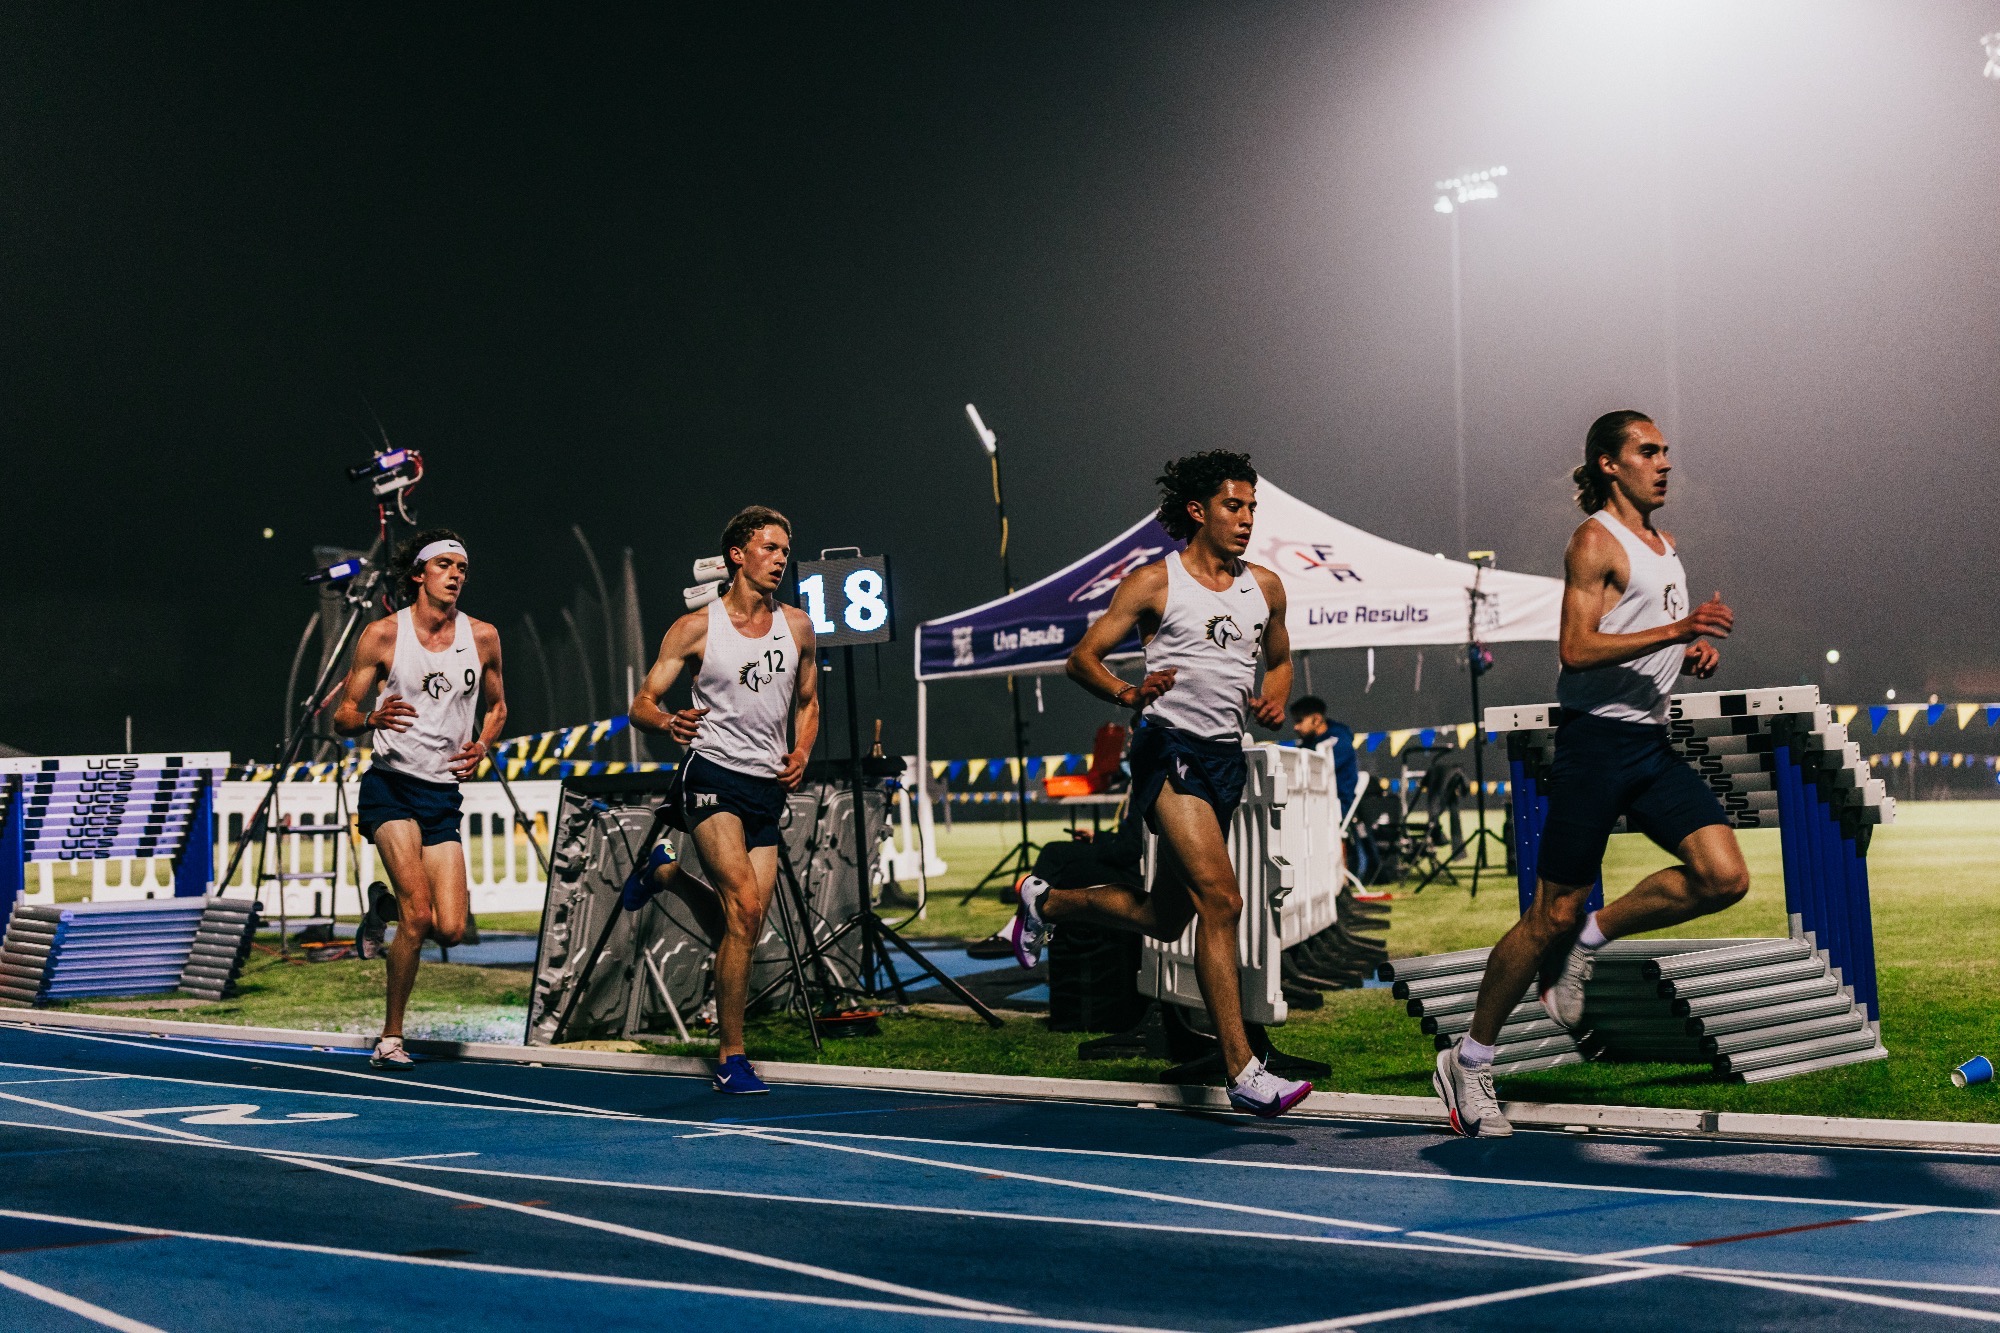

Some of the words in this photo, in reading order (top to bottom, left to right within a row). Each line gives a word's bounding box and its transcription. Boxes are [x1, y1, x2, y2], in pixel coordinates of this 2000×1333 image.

[799, 569, 888, 634] 18
[1308, 607, 1348, 625] Live
[1355, 605, 1429, 623] Results
[993, 631, 1018, 651] Live
[1019, 624, 1065, 649] Results
[763, 650, 786, 673] 12
[463, 668, 476, 695] 9
[87, 758, 139, 769] UCS
[83, 770, 136, 781] UCS
[80, 782, 132, 792] UCS
[76, 794, 129, 804] UCS
[693, 792, 720, 808] M
[73, 805, 126, 815] UCS
[70, 816, 122, 826] UCS
[66, 827, 119, 837] UCS
[61, 838, 114, 849] UCS
[58, 850, 111, 860] UCS
